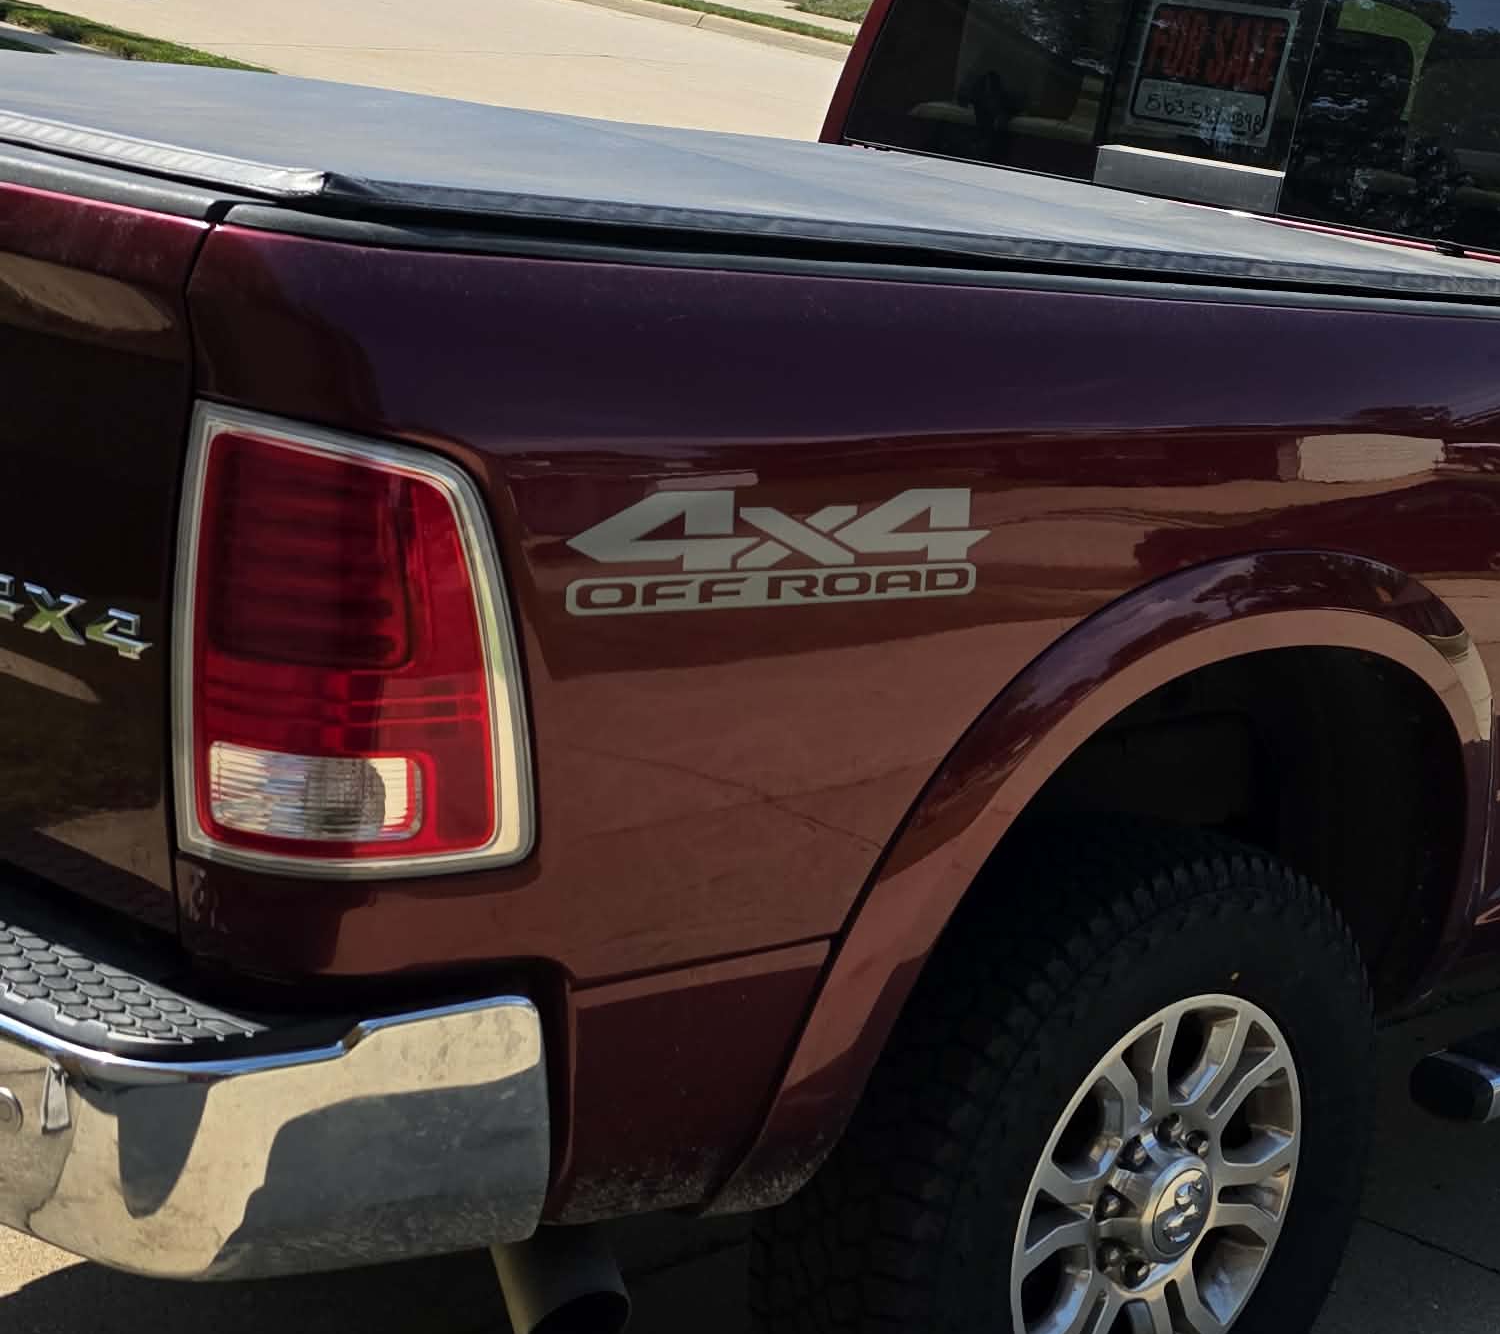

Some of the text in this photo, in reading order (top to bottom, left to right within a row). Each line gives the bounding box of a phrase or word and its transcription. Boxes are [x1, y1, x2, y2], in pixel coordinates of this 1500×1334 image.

[1144, 9, 1285, 92] FOR SALE
[575, 567, 970, 610] OFF ROAD
